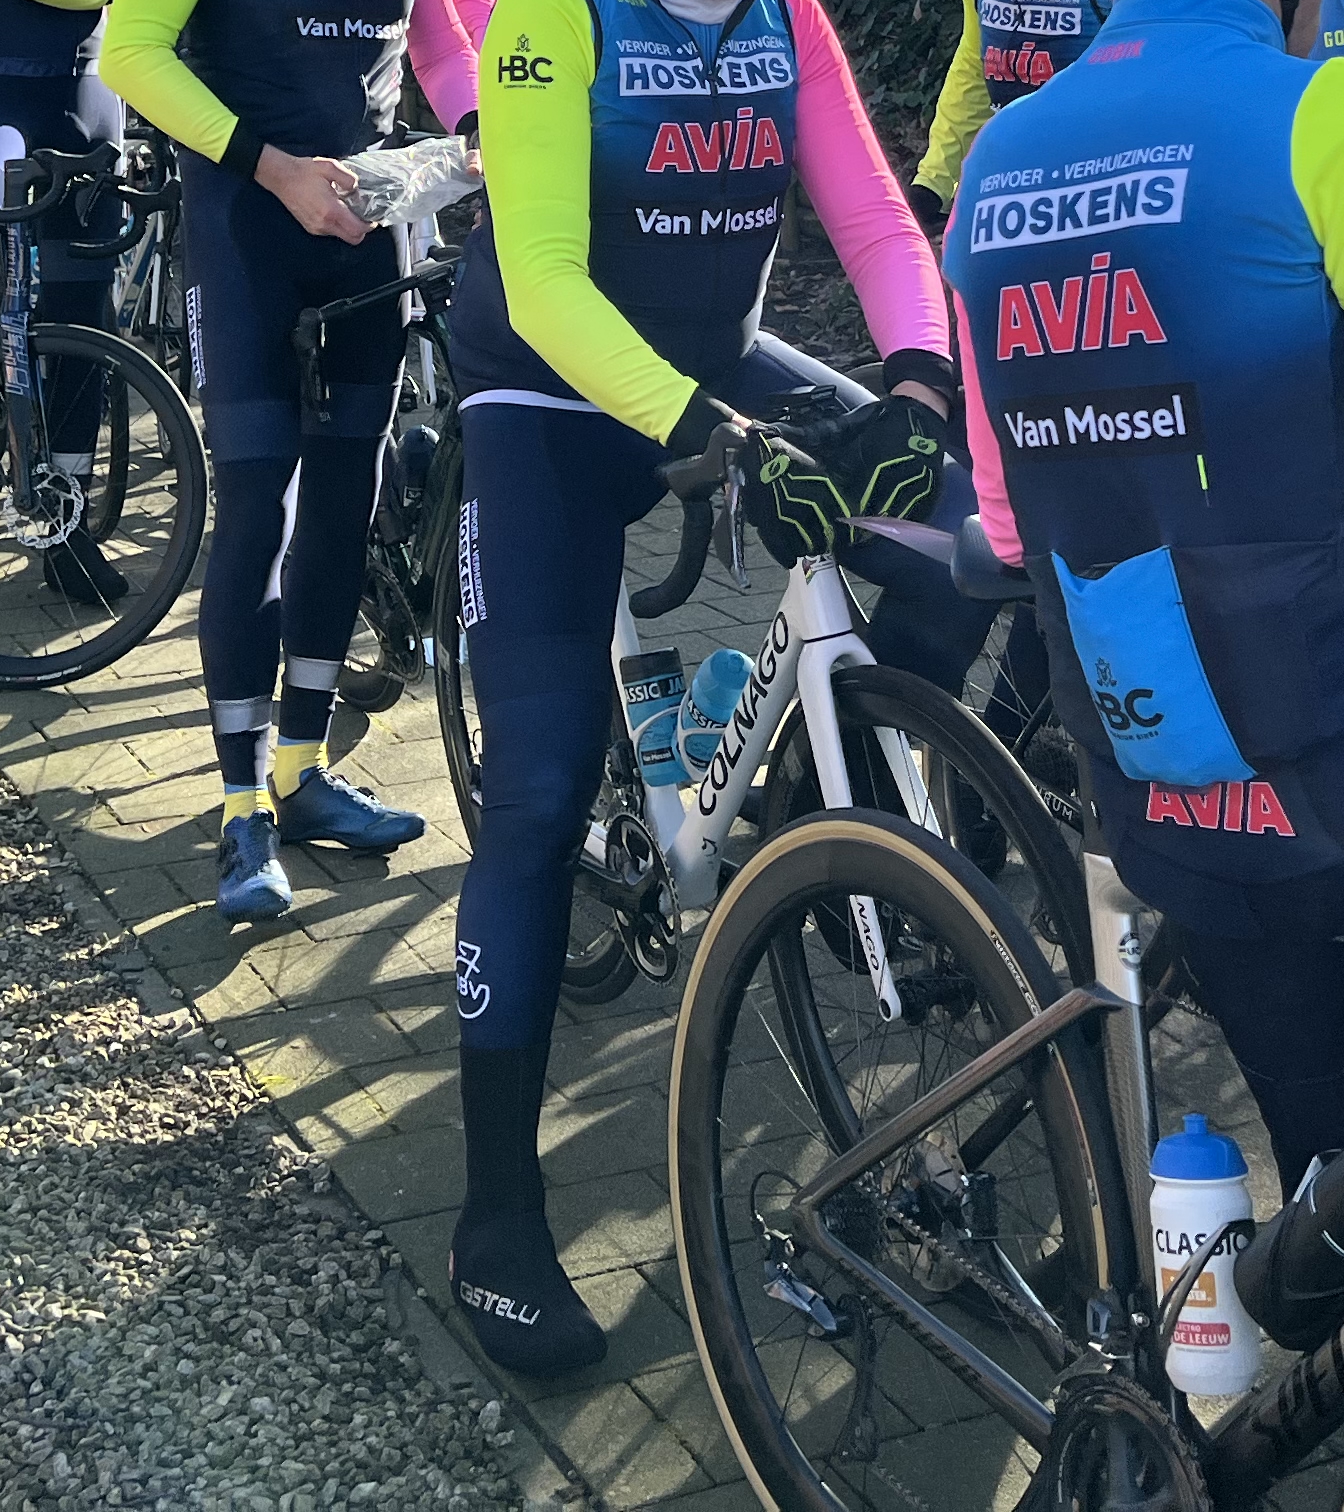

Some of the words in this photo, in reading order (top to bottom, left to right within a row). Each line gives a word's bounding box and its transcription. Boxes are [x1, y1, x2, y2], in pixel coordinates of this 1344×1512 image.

[296, 17, 338, 37] Van
[344, 18, 405, 39] Mossel
[615, 39, 672, 56] VERVOER
[497, 55, 555, 84] HBC
[624, 57, 789, 90] HOSKENS
[645, 106, 785, 173] AVIA
[979, 167, 1044, 194] VERVOER
[1063, 143, 1195, 181] VERHUIZINGEN
[635, 207, 691, 236] Van
[973, 175, 1175, 245] HOSKENS
[996, 251, 1168, 362] AVIA
[1004, 409, 1060, 449] Van
[1064, 394, 1187, 445] Mossel
[459, 506, 475, 624] HOSKENS
[699, 611, 789, 817] COLNAGO
[1092, 688, 1165, 731] BC
[1145, 780, 1297, 838] AVIA
[855, 900, 880, 972] NAGO
[1173, 1332, 1188, 1344] DE
[1189, 1334, 1231, 1345] LEEUW
